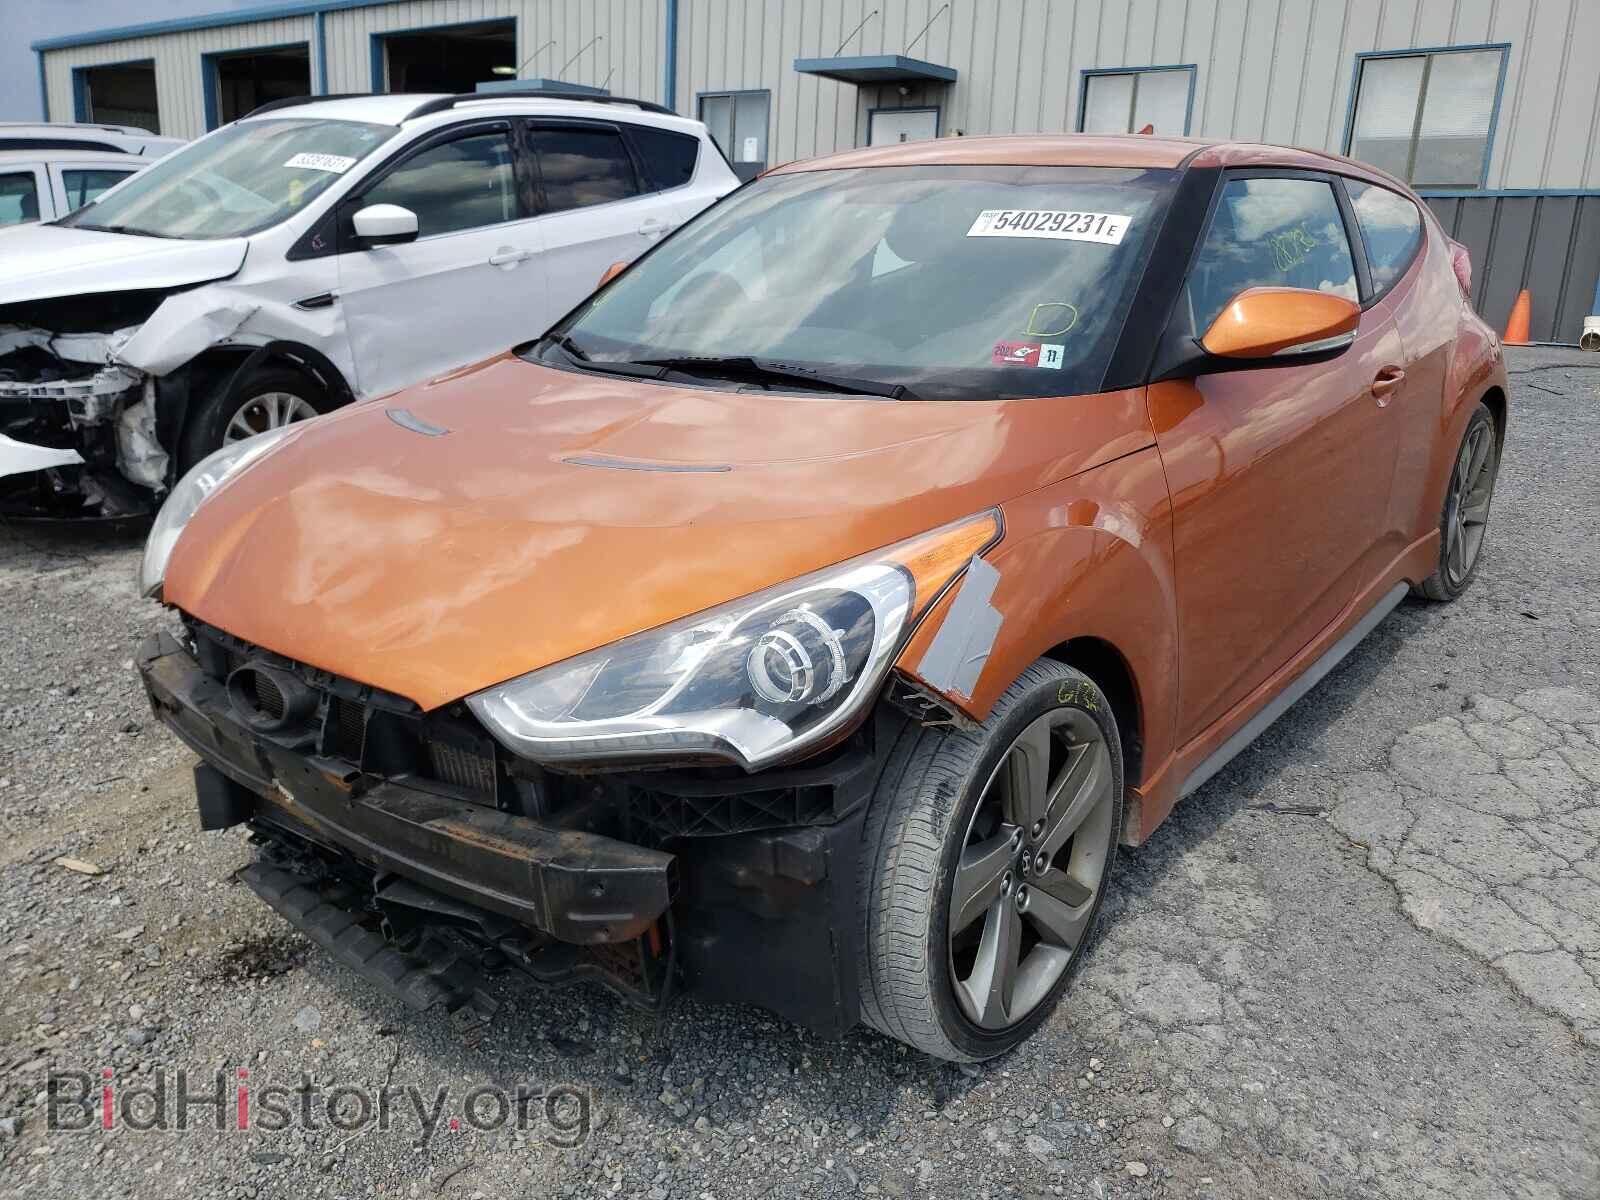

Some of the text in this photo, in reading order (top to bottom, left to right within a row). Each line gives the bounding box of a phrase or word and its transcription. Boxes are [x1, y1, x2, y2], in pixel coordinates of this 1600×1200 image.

[994, 211, 1108, 235] 54029231
[1107, 225, 1118, 236] E
[1047, 349, 1057, 363] 11
